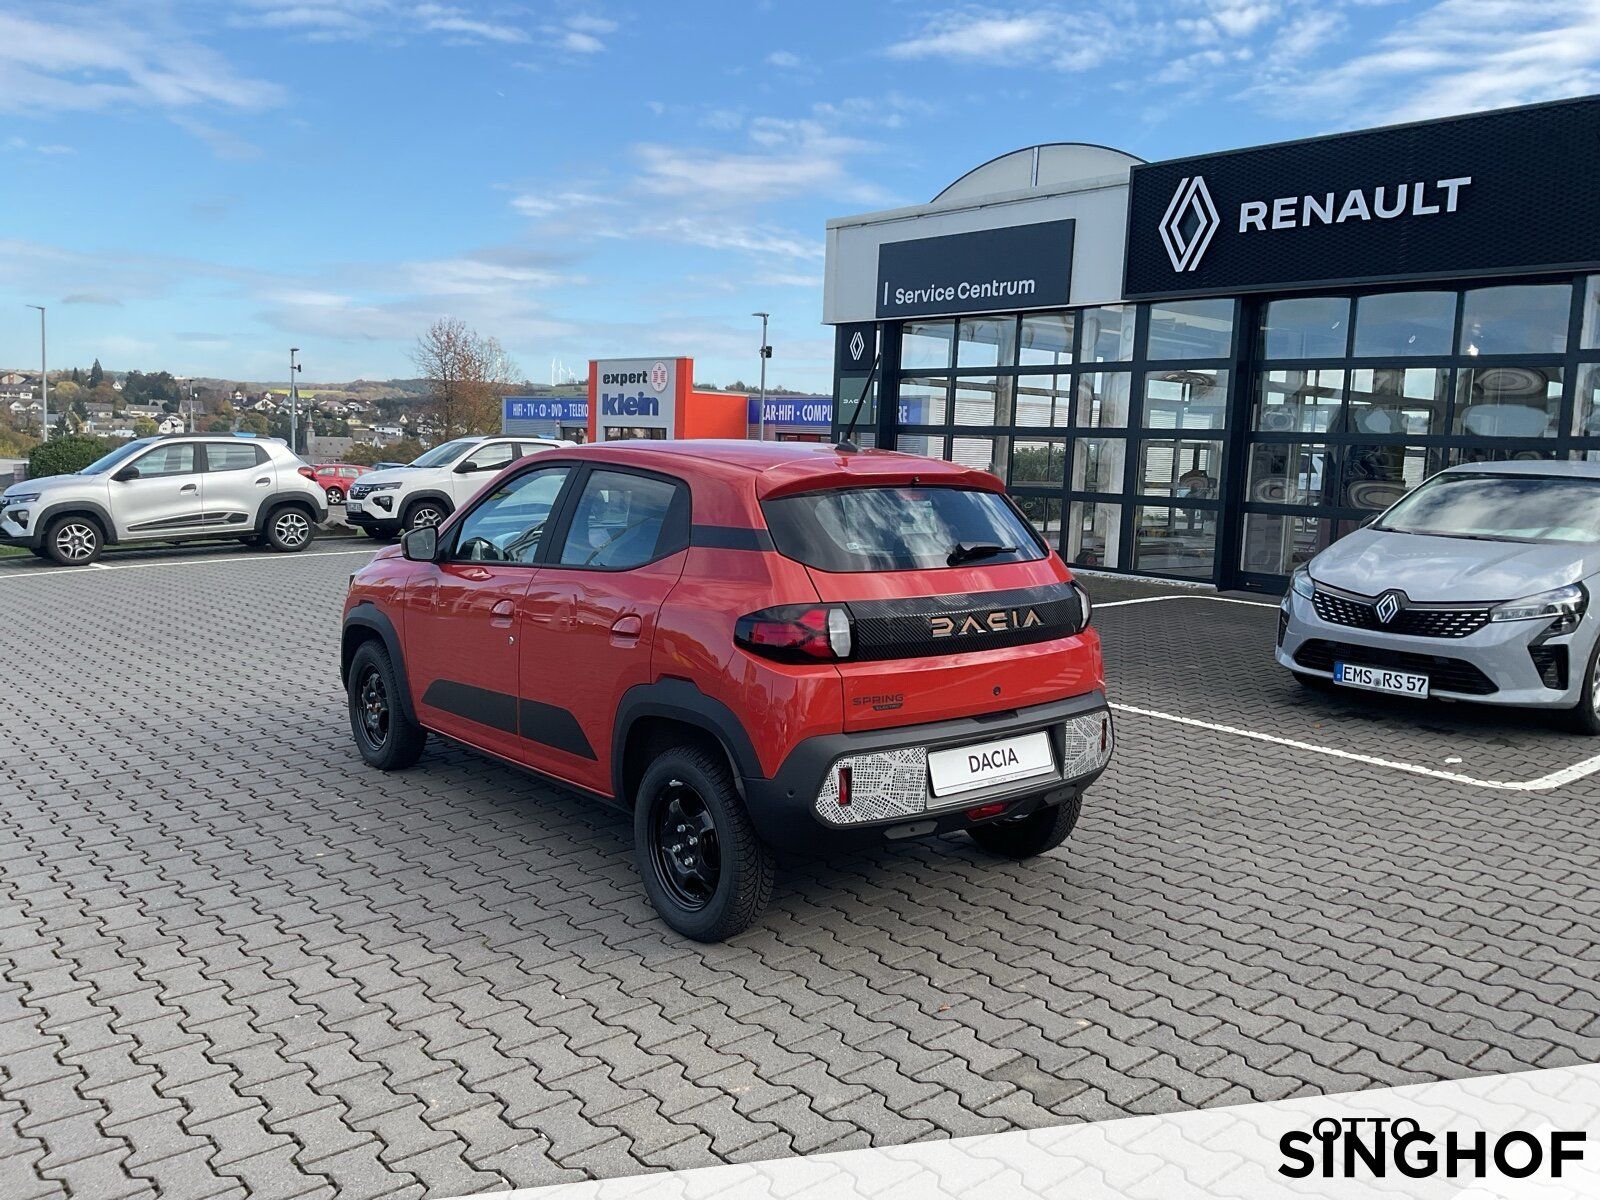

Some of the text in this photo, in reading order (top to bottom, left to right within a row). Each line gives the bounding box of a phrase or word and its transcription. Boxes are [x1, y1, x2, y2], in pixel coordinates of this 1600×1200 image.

[1239, 177, 1472, 233] RENAULT
[895, 279, 1036, 305] Service Centrum
[603, 371, 648, 386] expert
[602, 391, 659, 416] klein
[931, 609, 1045, 638] DACIA
[1343, 666, 1427, 693] EMS RS 57
[852, 693, 904, 706] SPRING
[968, 748, 1019, 774] DACIA
